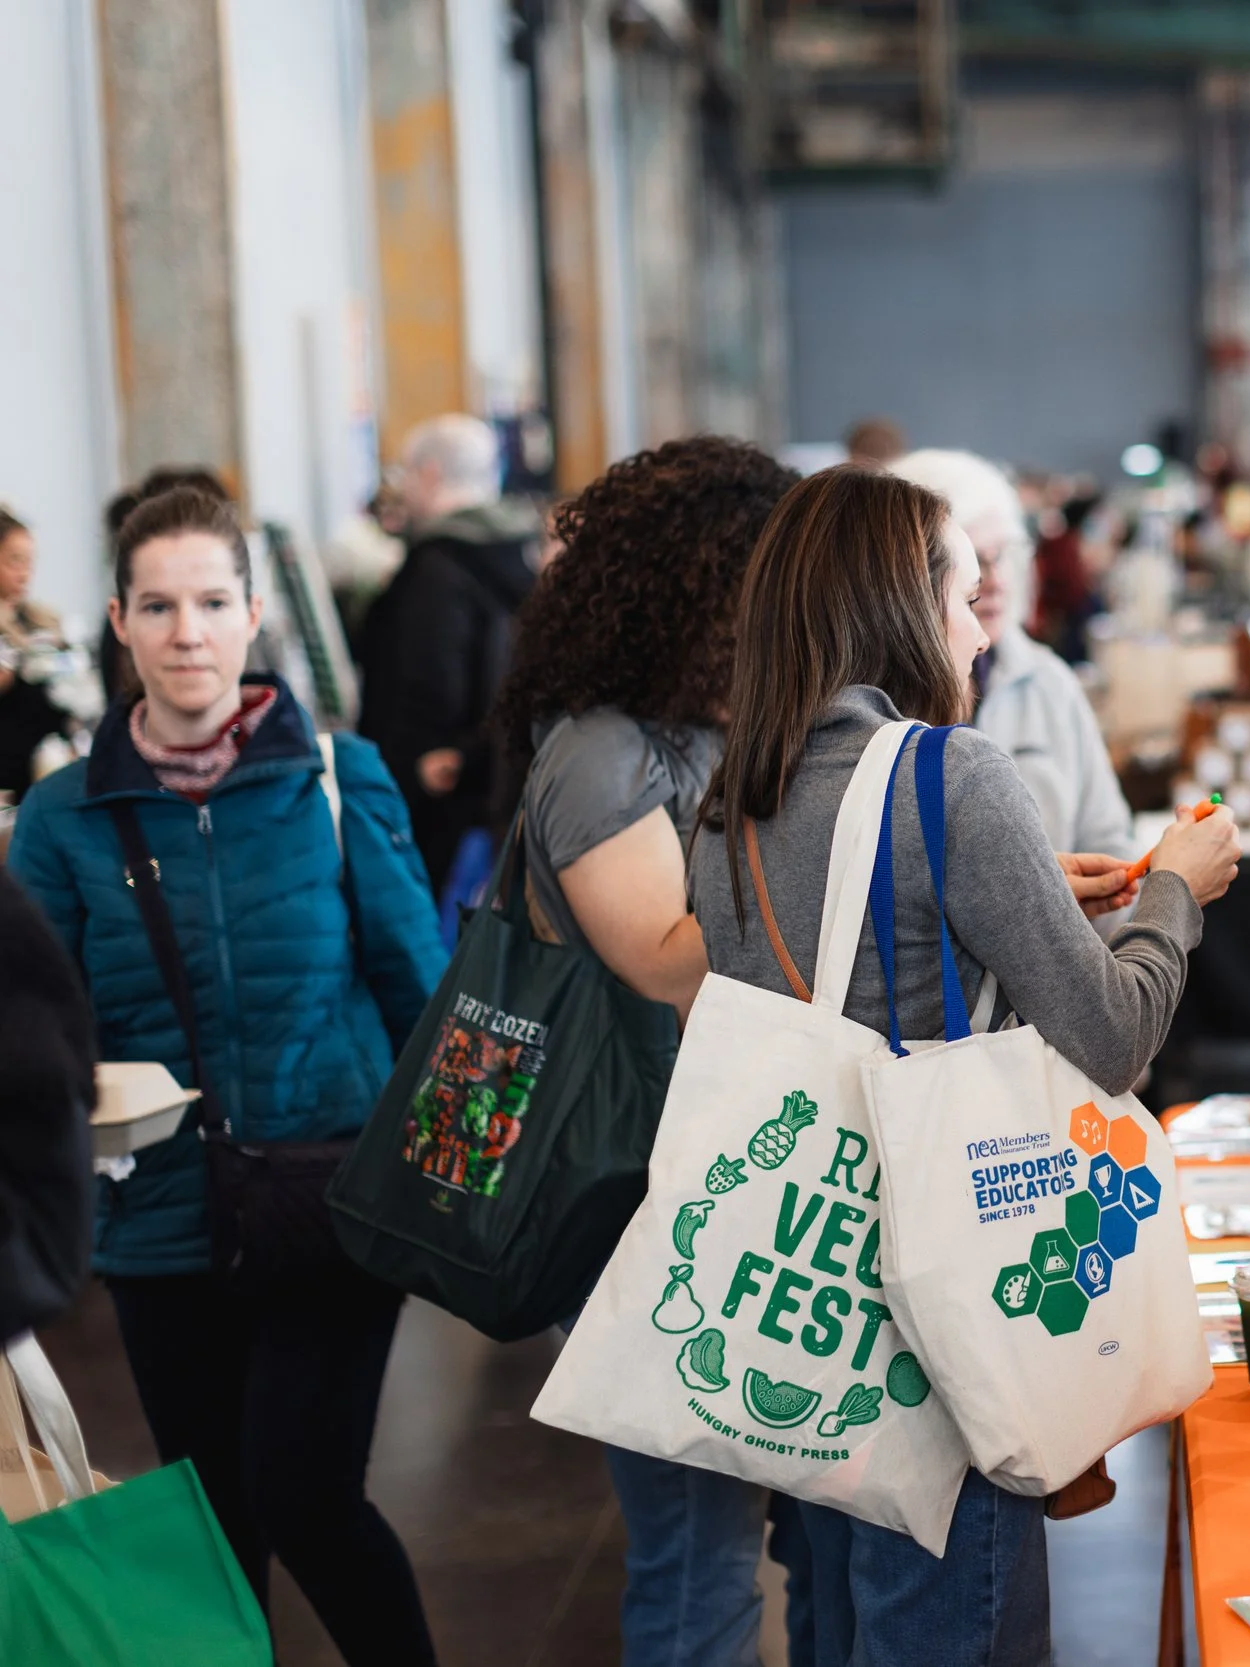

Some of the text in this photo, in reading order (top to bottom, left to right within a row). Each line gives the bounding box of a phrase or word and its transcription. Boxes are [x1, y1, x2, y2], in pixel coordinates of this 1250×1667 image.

[966, 1131, 1051, 1160] nea Members
[1000, 1140, 1051, 1155] Insurance Trust
[979, 1203, 1036, 1224] SINCE 1978
[720, 1250, 894, 1372] FEST
[687, 1397, 850, 1461] HUNGRY GHOST PRESS
